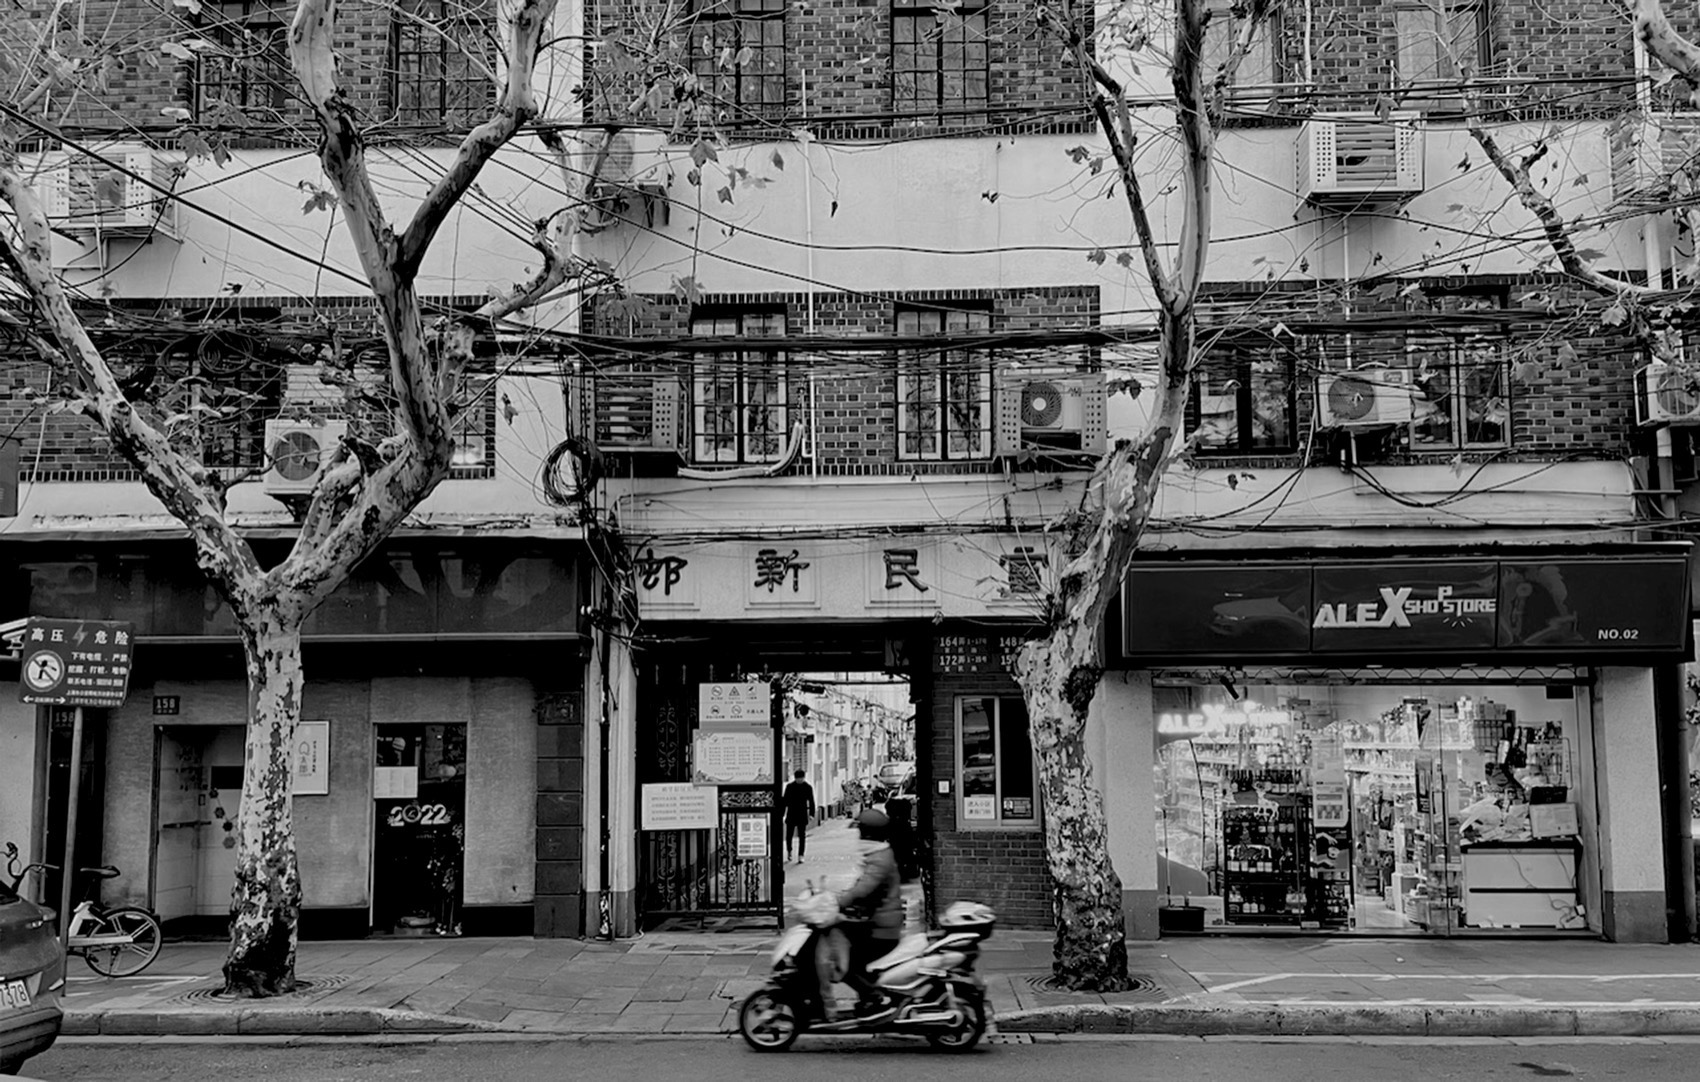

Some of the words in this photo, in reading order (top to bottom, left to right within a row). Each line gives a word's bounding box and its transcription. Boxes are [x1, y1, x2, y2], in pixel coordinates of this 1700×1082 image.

[1313, 587, 1412, 628] ALEX
[31, 627, 64, 642] 高压
[94, 629, 129, 645] 危险
[1598, 628, 1639, 640] NO.02
[156, 698, 175, 709] 158
[1157, 703, 1226, 733] ALEX
